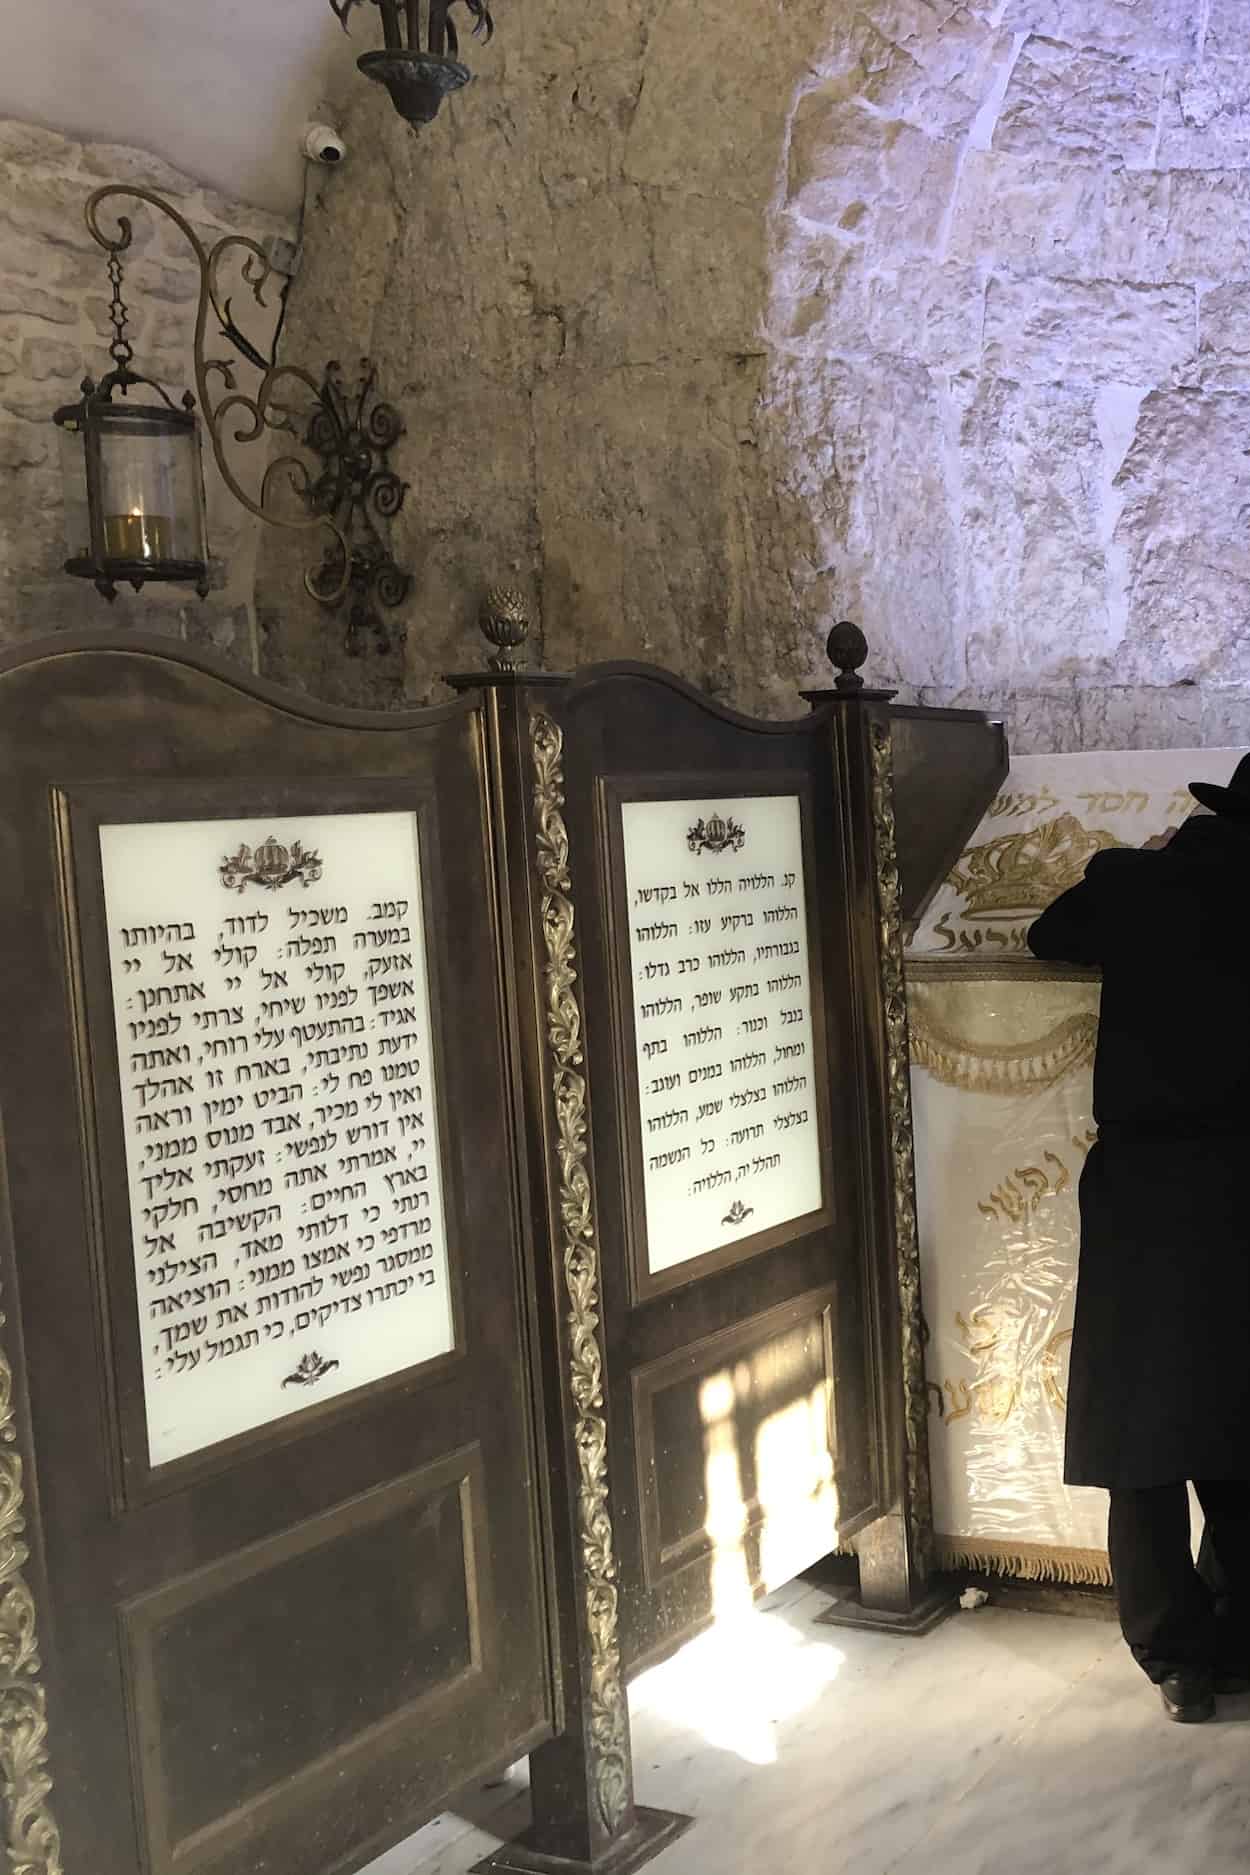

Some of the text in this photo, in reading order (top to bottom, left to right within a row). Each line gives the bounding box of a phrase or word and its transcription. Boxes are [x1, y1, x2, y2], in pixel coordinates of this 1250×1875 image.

[634, 872, 796, 908] קנ. הללויה הללו אל בקדשו,
[119, 900, 409, 948] קמב. משכיל לדוד, בהיותו
[720, 912, 755, 933] ברקיע
[762, 904, 799, 924] הללוהו
[352, 926, 412, 950] במערה
[635, 920, 678, 943] הללוהו
[160, 949, 194, 975] אל
[211, 943, 258, 969] קולי
[706, 947, 746, 969] הללוהו
[753, 940, 800, 964] בגבורתיו,
[121, 957, 142, 974] יי
[304, 960, 346, 985] קולי
[363, 952, 414, 981] אזעק,
[677, 957, 701, 975] כרב
[223, 975, 242, 991] יי
[258, 967, 289, 992] אל
[639, 972, 802, 1019] הללוהו בתקע שופר, הללוהו
[127, 979, 416, 1041] אשפך לפניו שיחי, צרתי לפניו
[779, 1008, 804, 1025] בנבל
[252, 1026, 285, 1050] עלי
[288, 1015, 366, 1049] בהתעטף
[682, 1025, 723, 1048] הללוהו
[129, 1043, 191, 1073] ואתה
[197, 1035, 249, 1067] רוחי,
[642, 1039, 669, 1061] בתף
[729, 1051, 767, 1073] הללוהו
[773, 1041, 806, 1065] ומחול,
[131, 1031, 418, 1108] ידעת נתיבתי, בארח זו אהלך
[347, 1068, 373, 1090] פח
[379, 1058, 421, 1082] טמנו
[687, 1063, 723, 1084] במנים
[201, 1094, 244, 1125] ימין
[252, 1083, 304, 1110] הביט
[646, 1074, 807, 1133] הללוהו בצלצלי שמע, הללוהו
[135, 1104, 193, 1135] וראה
[138, 1084, 423, 1169] ואין לי מכיר, אבד מנוס ממני,
[345, 1119, 390, 1146] דורש
[396, 1111, 425, 1137] אין
[772, 1109, 809, 1131] בצלצלי
[648, 1146, 691, 1172] הנשמה
[699, 1137, 716, 1155] כל
[202, 1149, 265, 1180] זעקתי
[734, 1162, 751, 1184] יה,
[751, 1153, 781, 1175] תהלל
[138, 1166, 195, 1201] אליך
[141, 1137, 426, 1231] יי, אמרתי אתה מחסי, חלקי
[382, 1164, 429, 1194] בארץ
[197, 1204, 282, 1243] הקשיבה
[379, 1216, 432, 1246] מרדפי
[142, 1231, 177, 1259] אל
[146, 1190, 430, 1287] רנתי כי דלותי מאד, הצילני
[355, 1234, 376, 1253] כי
[300, 1239, 351, 1271] אמצו
[365, 1274, 415, 1306] יכתרו
[417, 1268, 436, 1287] בי
[148, 1278, 231, 1321] הוציאה
[153, 1242, 434, 1355] ממסגר נפשי להודות את שמך,
[289, 1292, 363, 1337] צדיקים,
[262, 1320, 285, 1340] כי
[203, 1328, 260, 1363] תגמל
